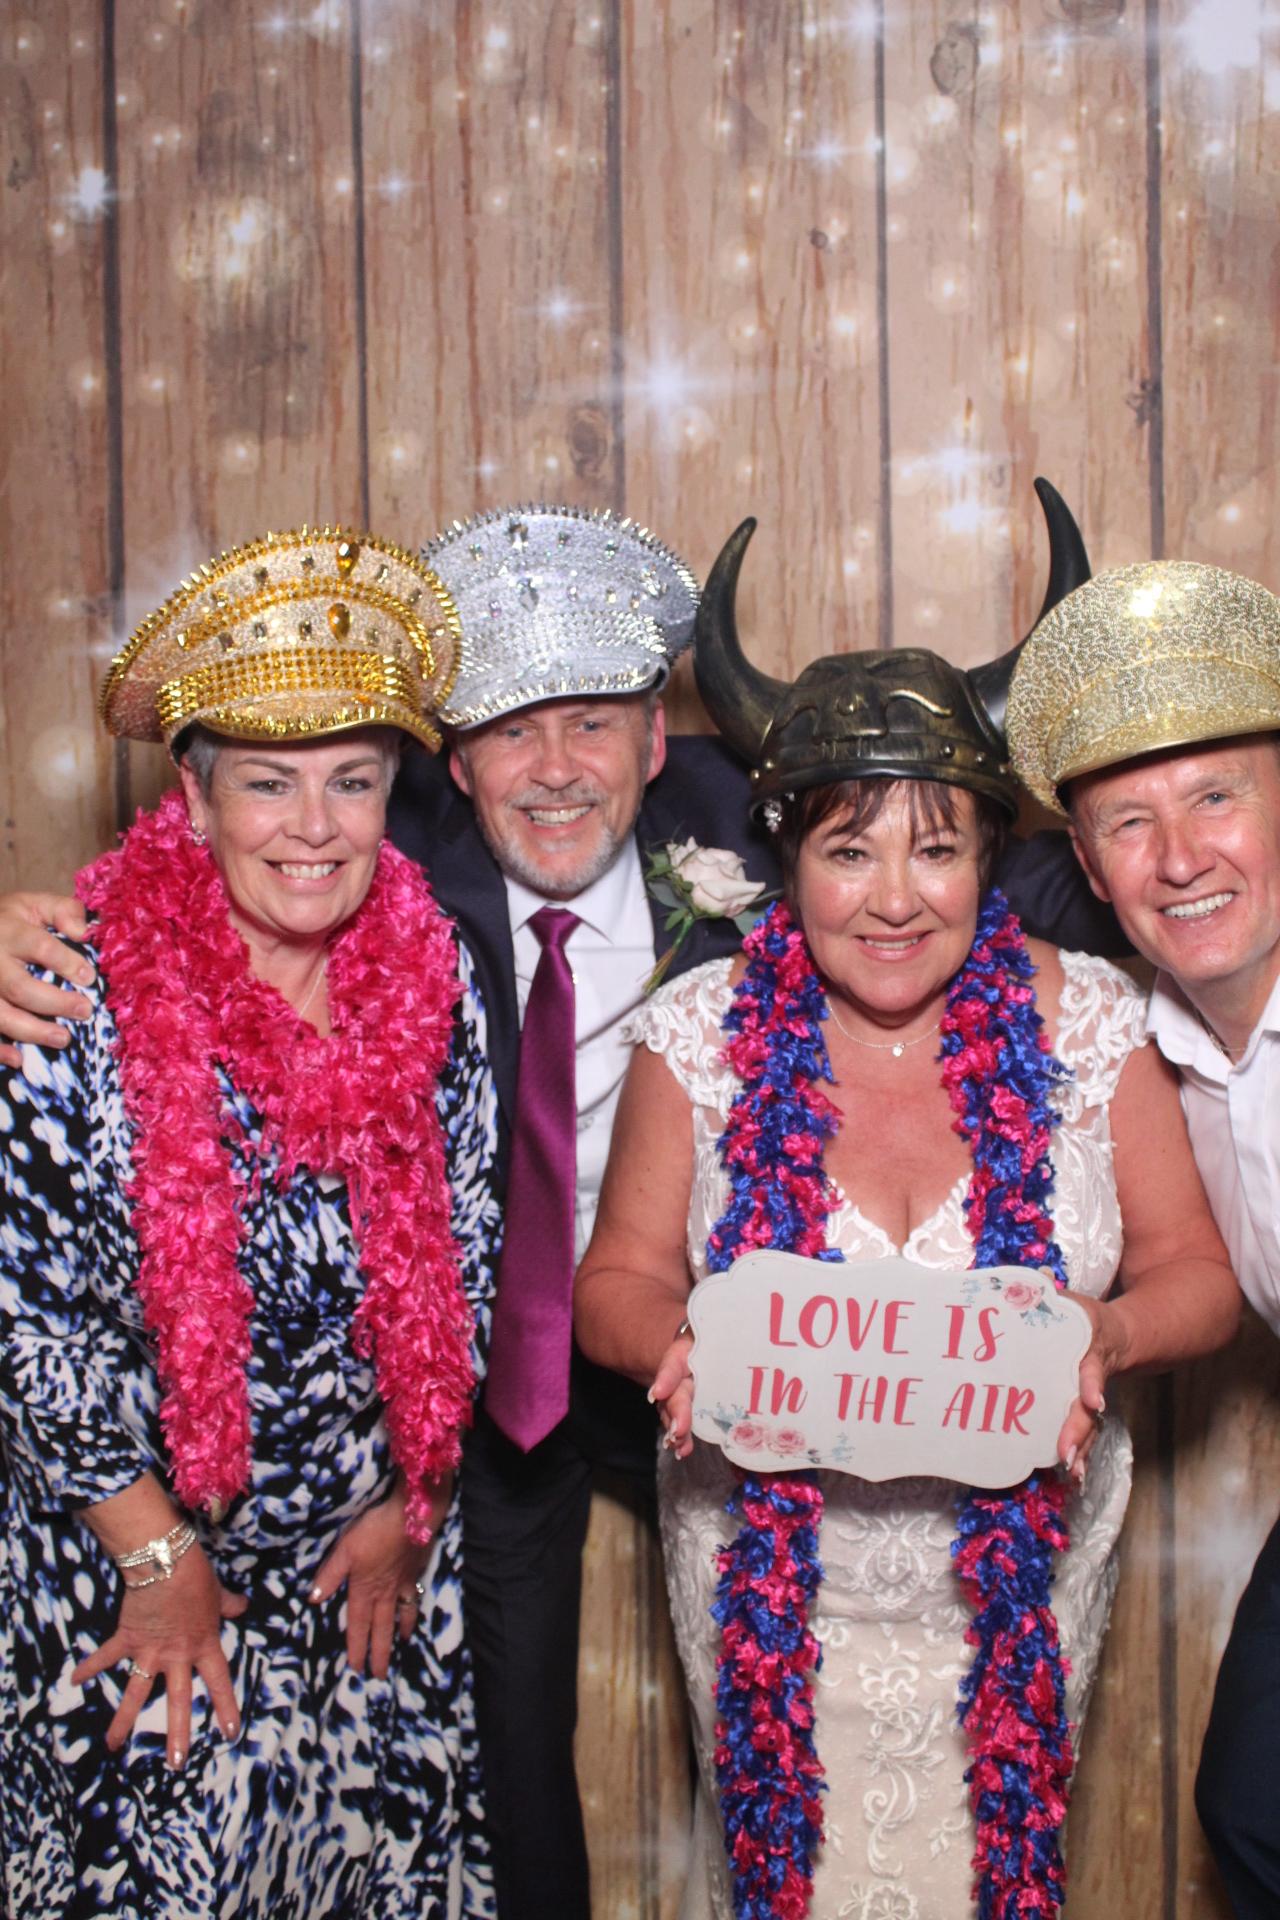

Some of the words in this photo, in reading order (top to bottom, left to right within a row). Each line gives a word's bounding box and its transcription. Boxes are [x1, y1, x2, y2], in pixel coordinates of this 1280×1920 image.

[769, 1292, 915, 1354] LOVE
[942, 1304, 1004, 1362] IS
[833, 1373, 924, 1426] THE
[942, 1383, 1036, 1436] AIR
